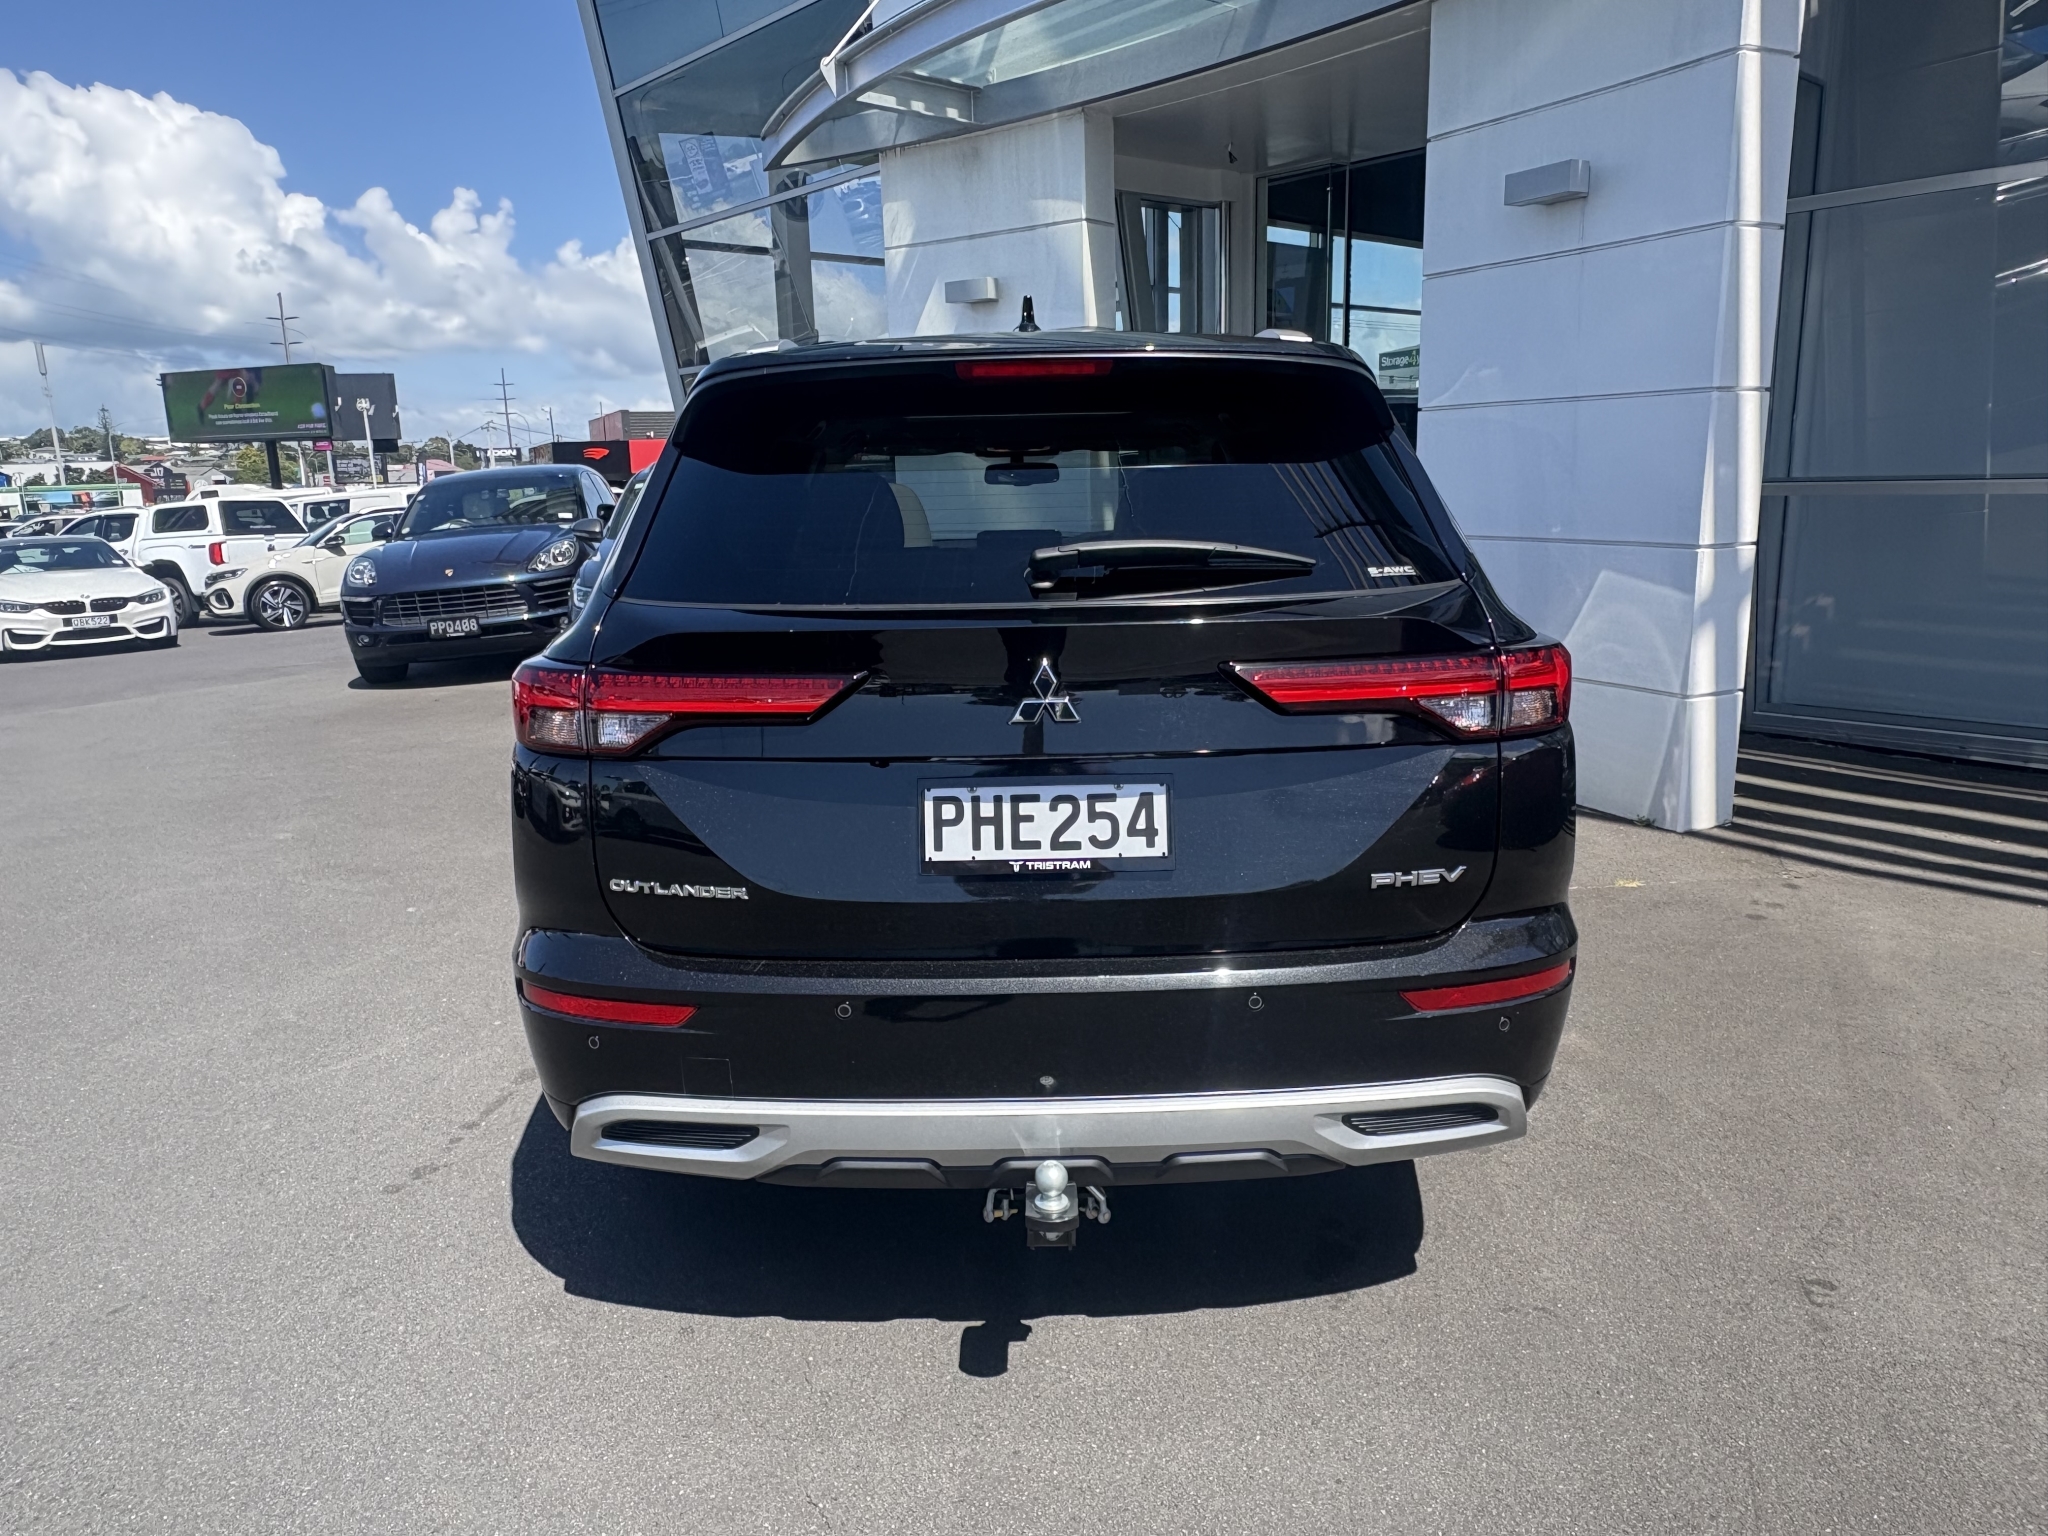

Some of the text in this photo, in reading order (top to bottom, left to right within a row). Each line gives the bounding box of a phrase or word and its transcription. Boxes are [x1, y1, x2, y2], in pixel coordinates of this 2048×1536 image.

[430, 618, 478, 635] PPQ408
[932, 791, 1159, 852] PHE254
[1025, 860, 1091, 871] TRISTRAM
[1370, 865, 1468, 889] PHEV
[609, 878, 749, 900] OUTLANDER
